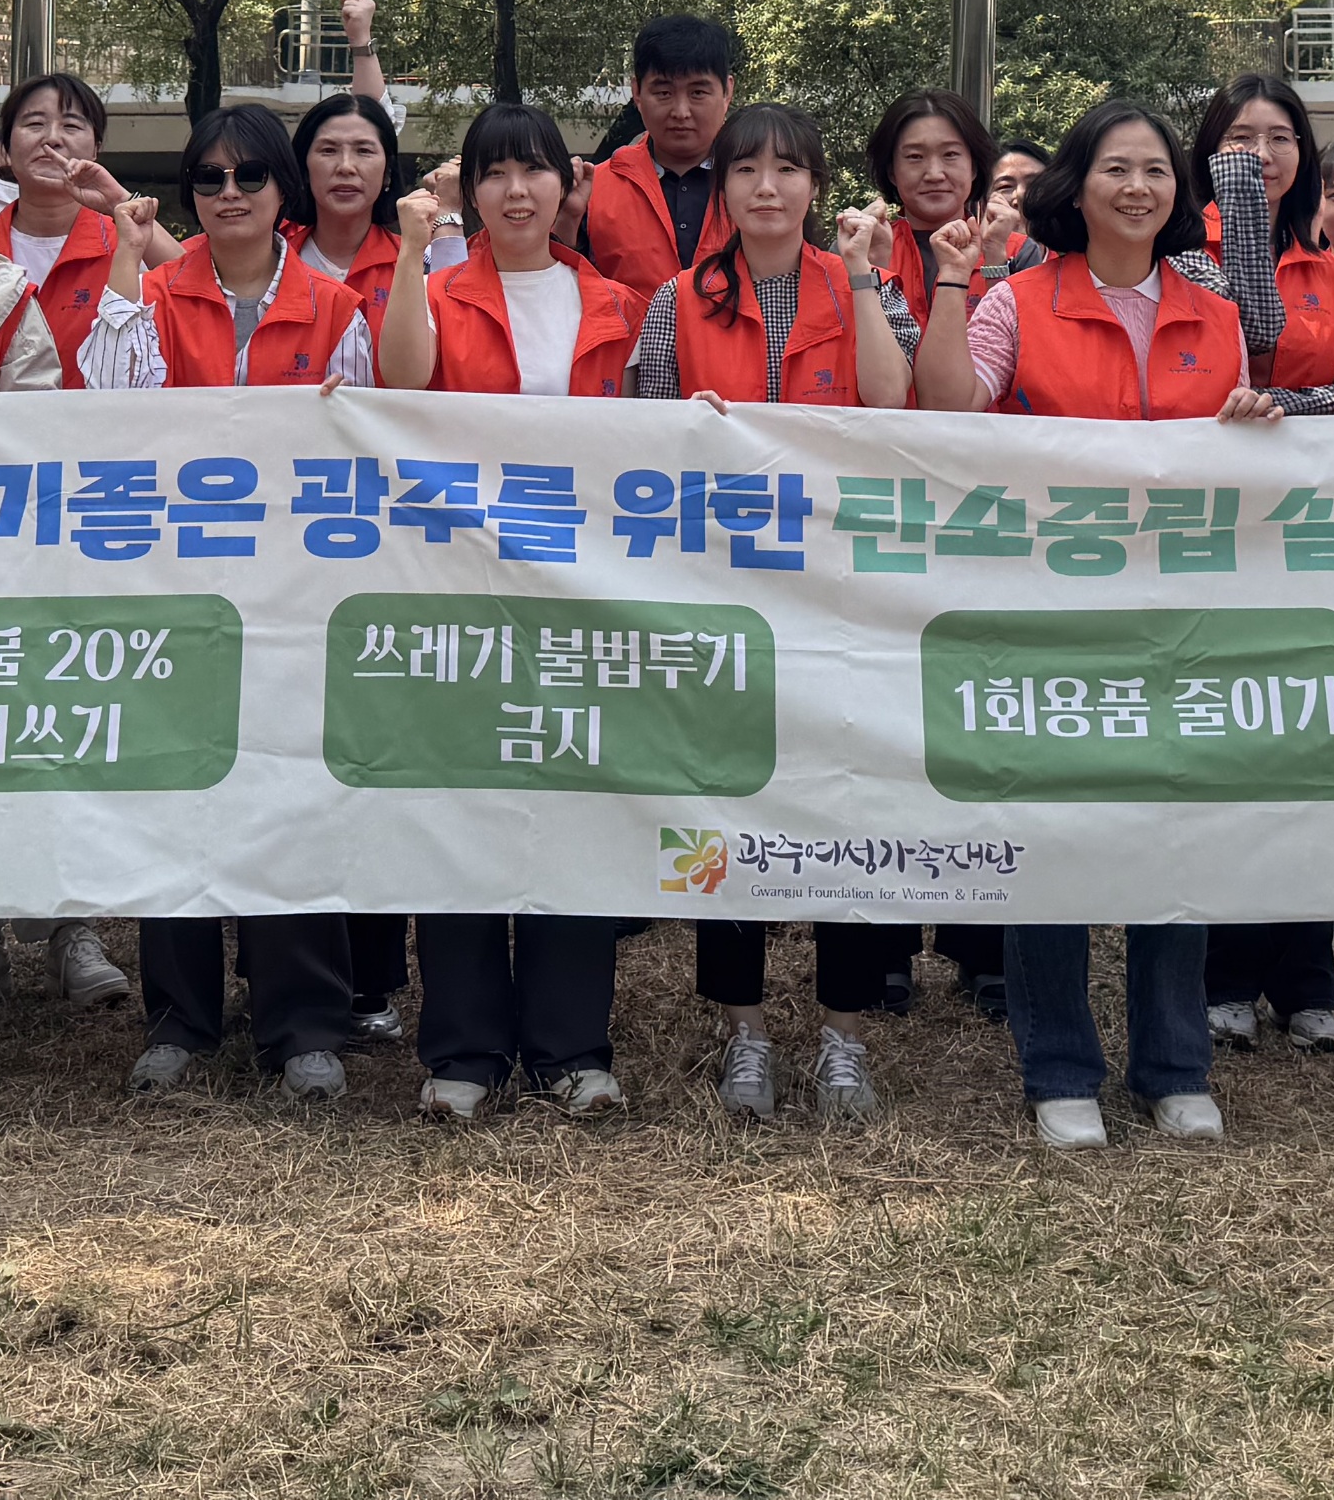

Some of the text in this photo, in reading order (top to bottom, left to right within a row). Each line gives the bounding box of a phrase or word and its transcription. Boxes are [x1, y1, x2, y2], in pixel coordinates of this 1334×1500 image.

[291, 457, 588, 565] 광주를
[613, 469, 813, 572] 위한
[832, 474, 1239, 577] 탄소중립
[44, 626, 175, 684] 20%
[352, 623, 748, 692] 쓰레기 불법투기
[496, 702, 601, 766] 금지
[954, 676, 1152, 739] 1회용품
[736, 832, 1025, 880] 광주여성가족재단
[750, 884, 1010, 902] Gwangju Foundation for Women & Family
